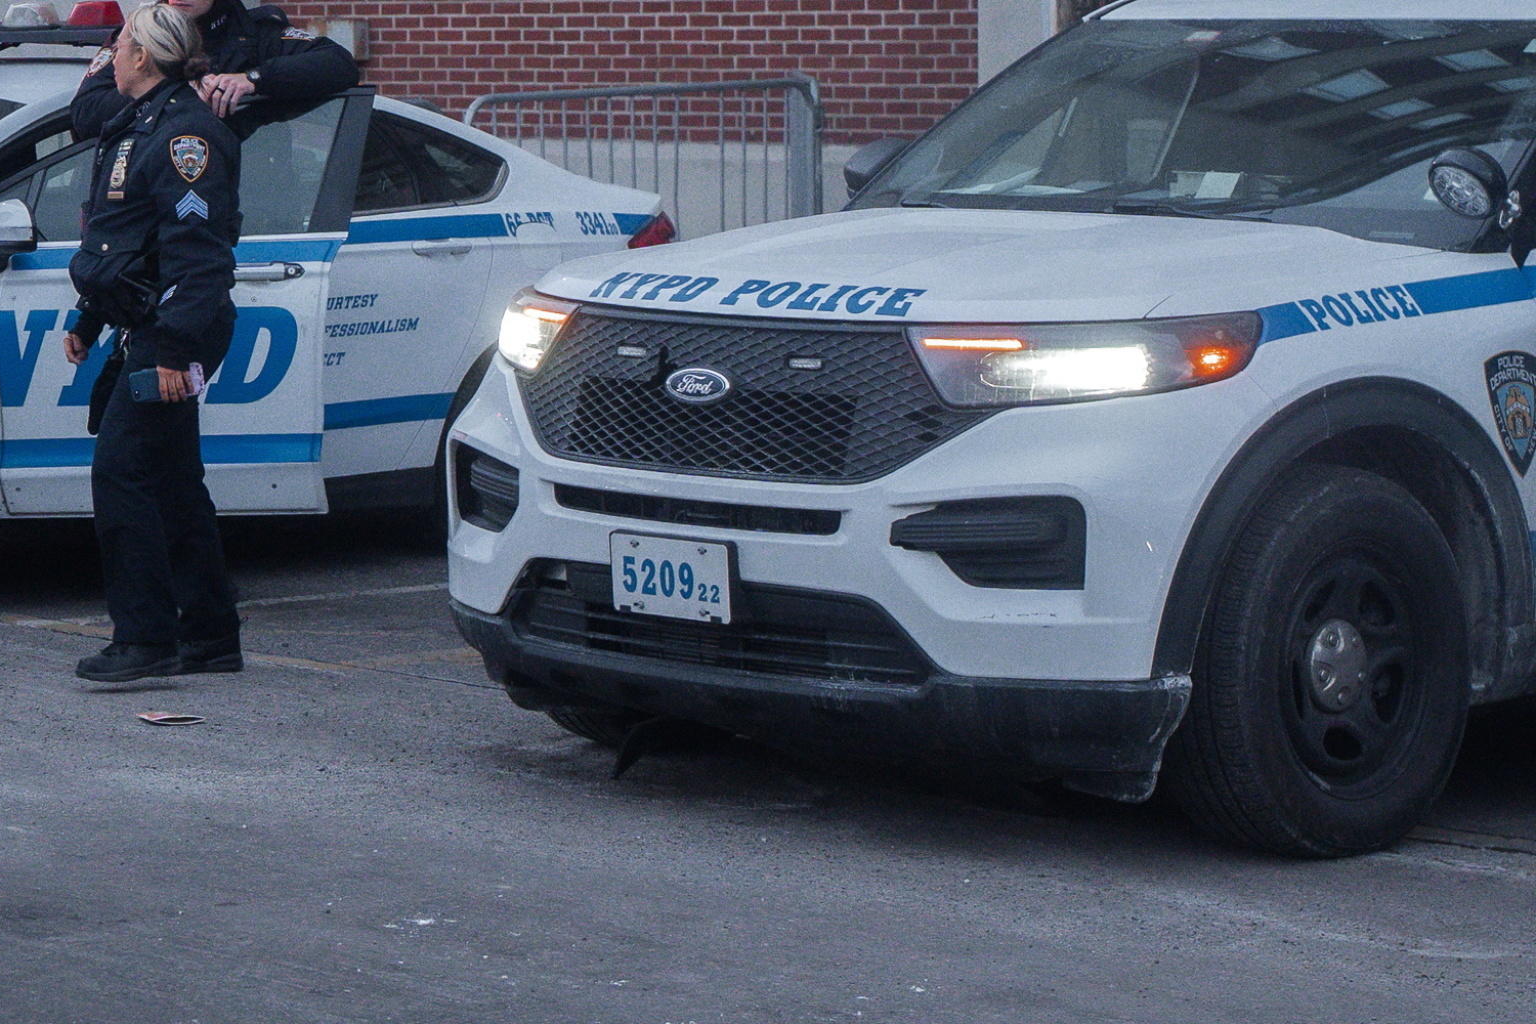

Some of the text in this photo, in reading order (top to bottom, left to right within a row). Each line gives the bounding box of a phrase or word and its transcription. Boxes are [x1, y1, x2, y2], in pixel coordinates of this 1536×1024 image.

[574, 211, 610, 236] 3341
[326, 293, 378, 311] URTESY
[588, 271, 928, 317] NYPD POLICE
[1298, 284, 1422, 331] POLICE
[324, 316, 420, 338] FESSIONALISM
[1497, 355, 1525, 370] POLICE
[677, 374, 713, 396] Ford
[622, 555, 721, 604] 5209 22
